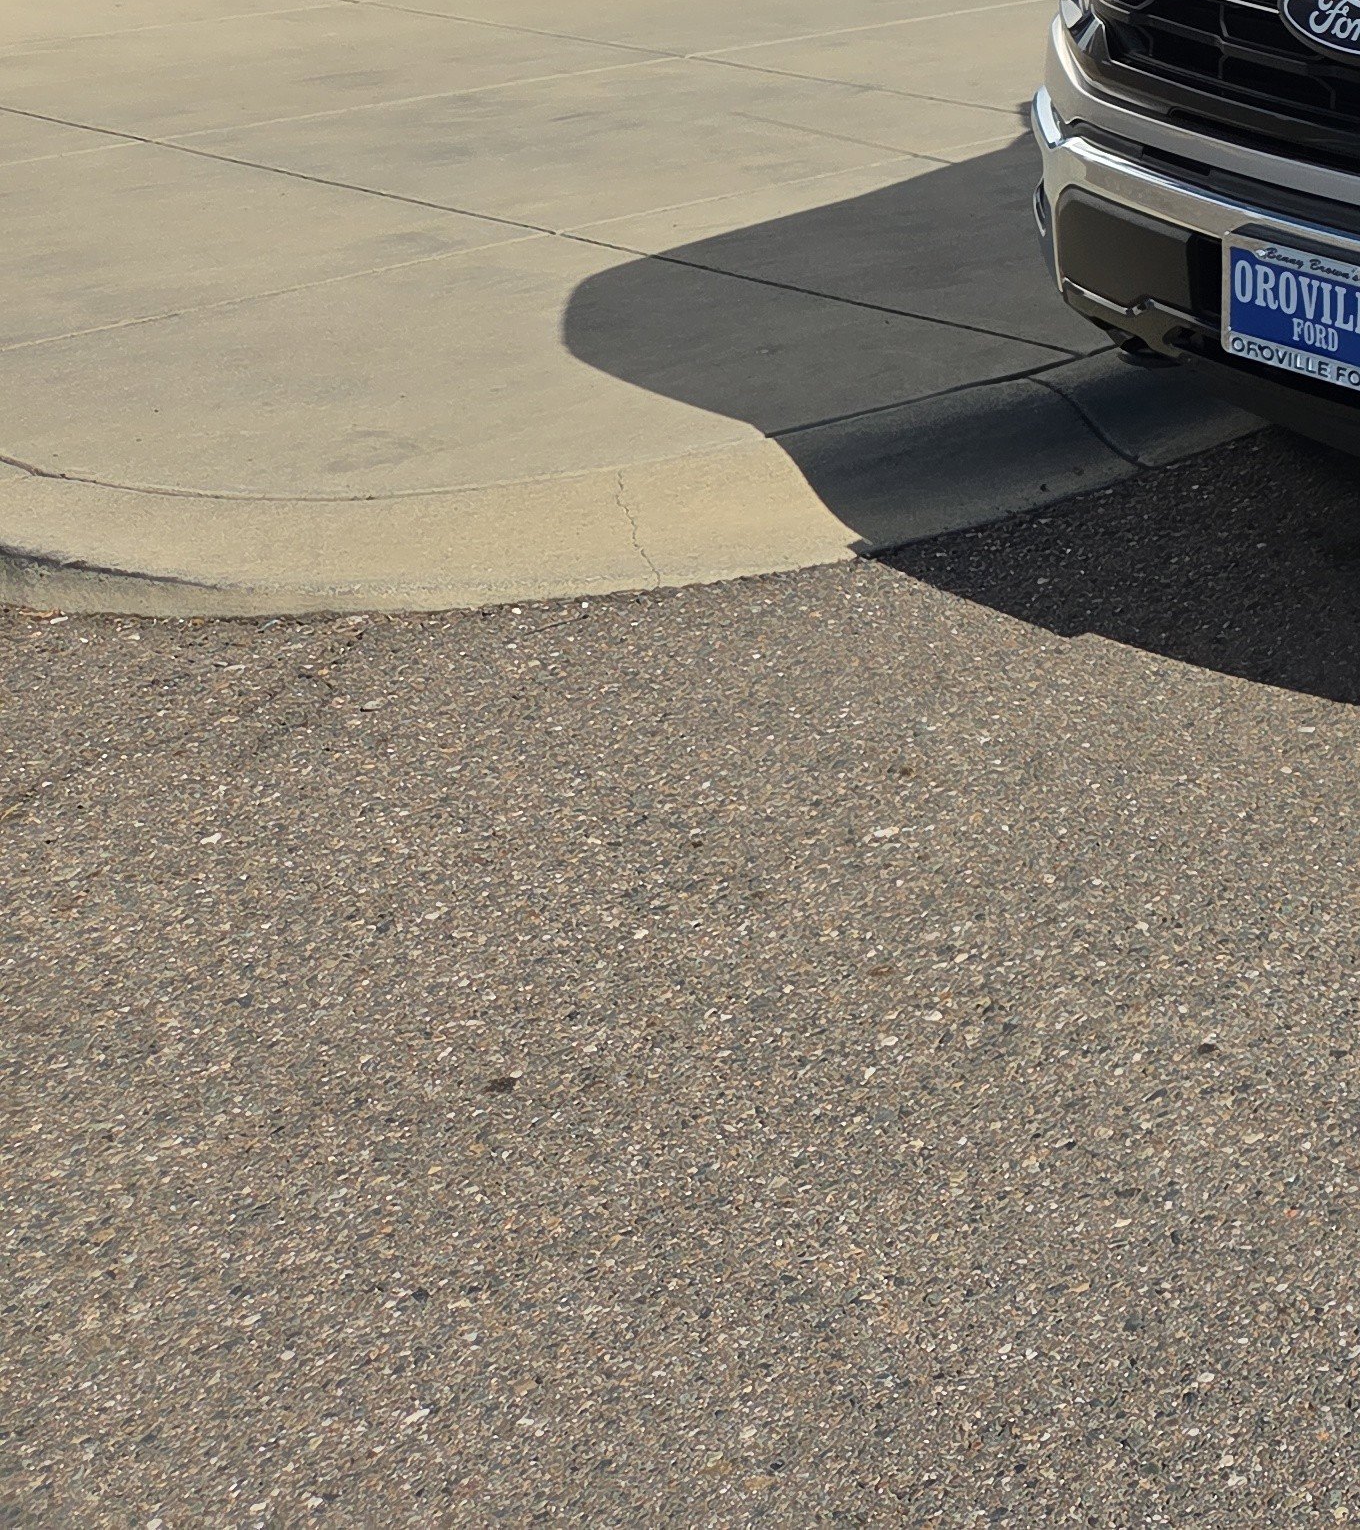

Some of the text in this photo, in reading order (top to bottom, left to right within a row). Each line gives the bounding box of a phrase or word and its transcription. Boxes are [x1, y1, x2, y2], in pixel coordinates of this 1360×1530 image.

[1263, 247, 1304, 269] Benny
[1292, 318, 1339, 353] FORD
[1231, 336, 1331, 376] OROVILLE
